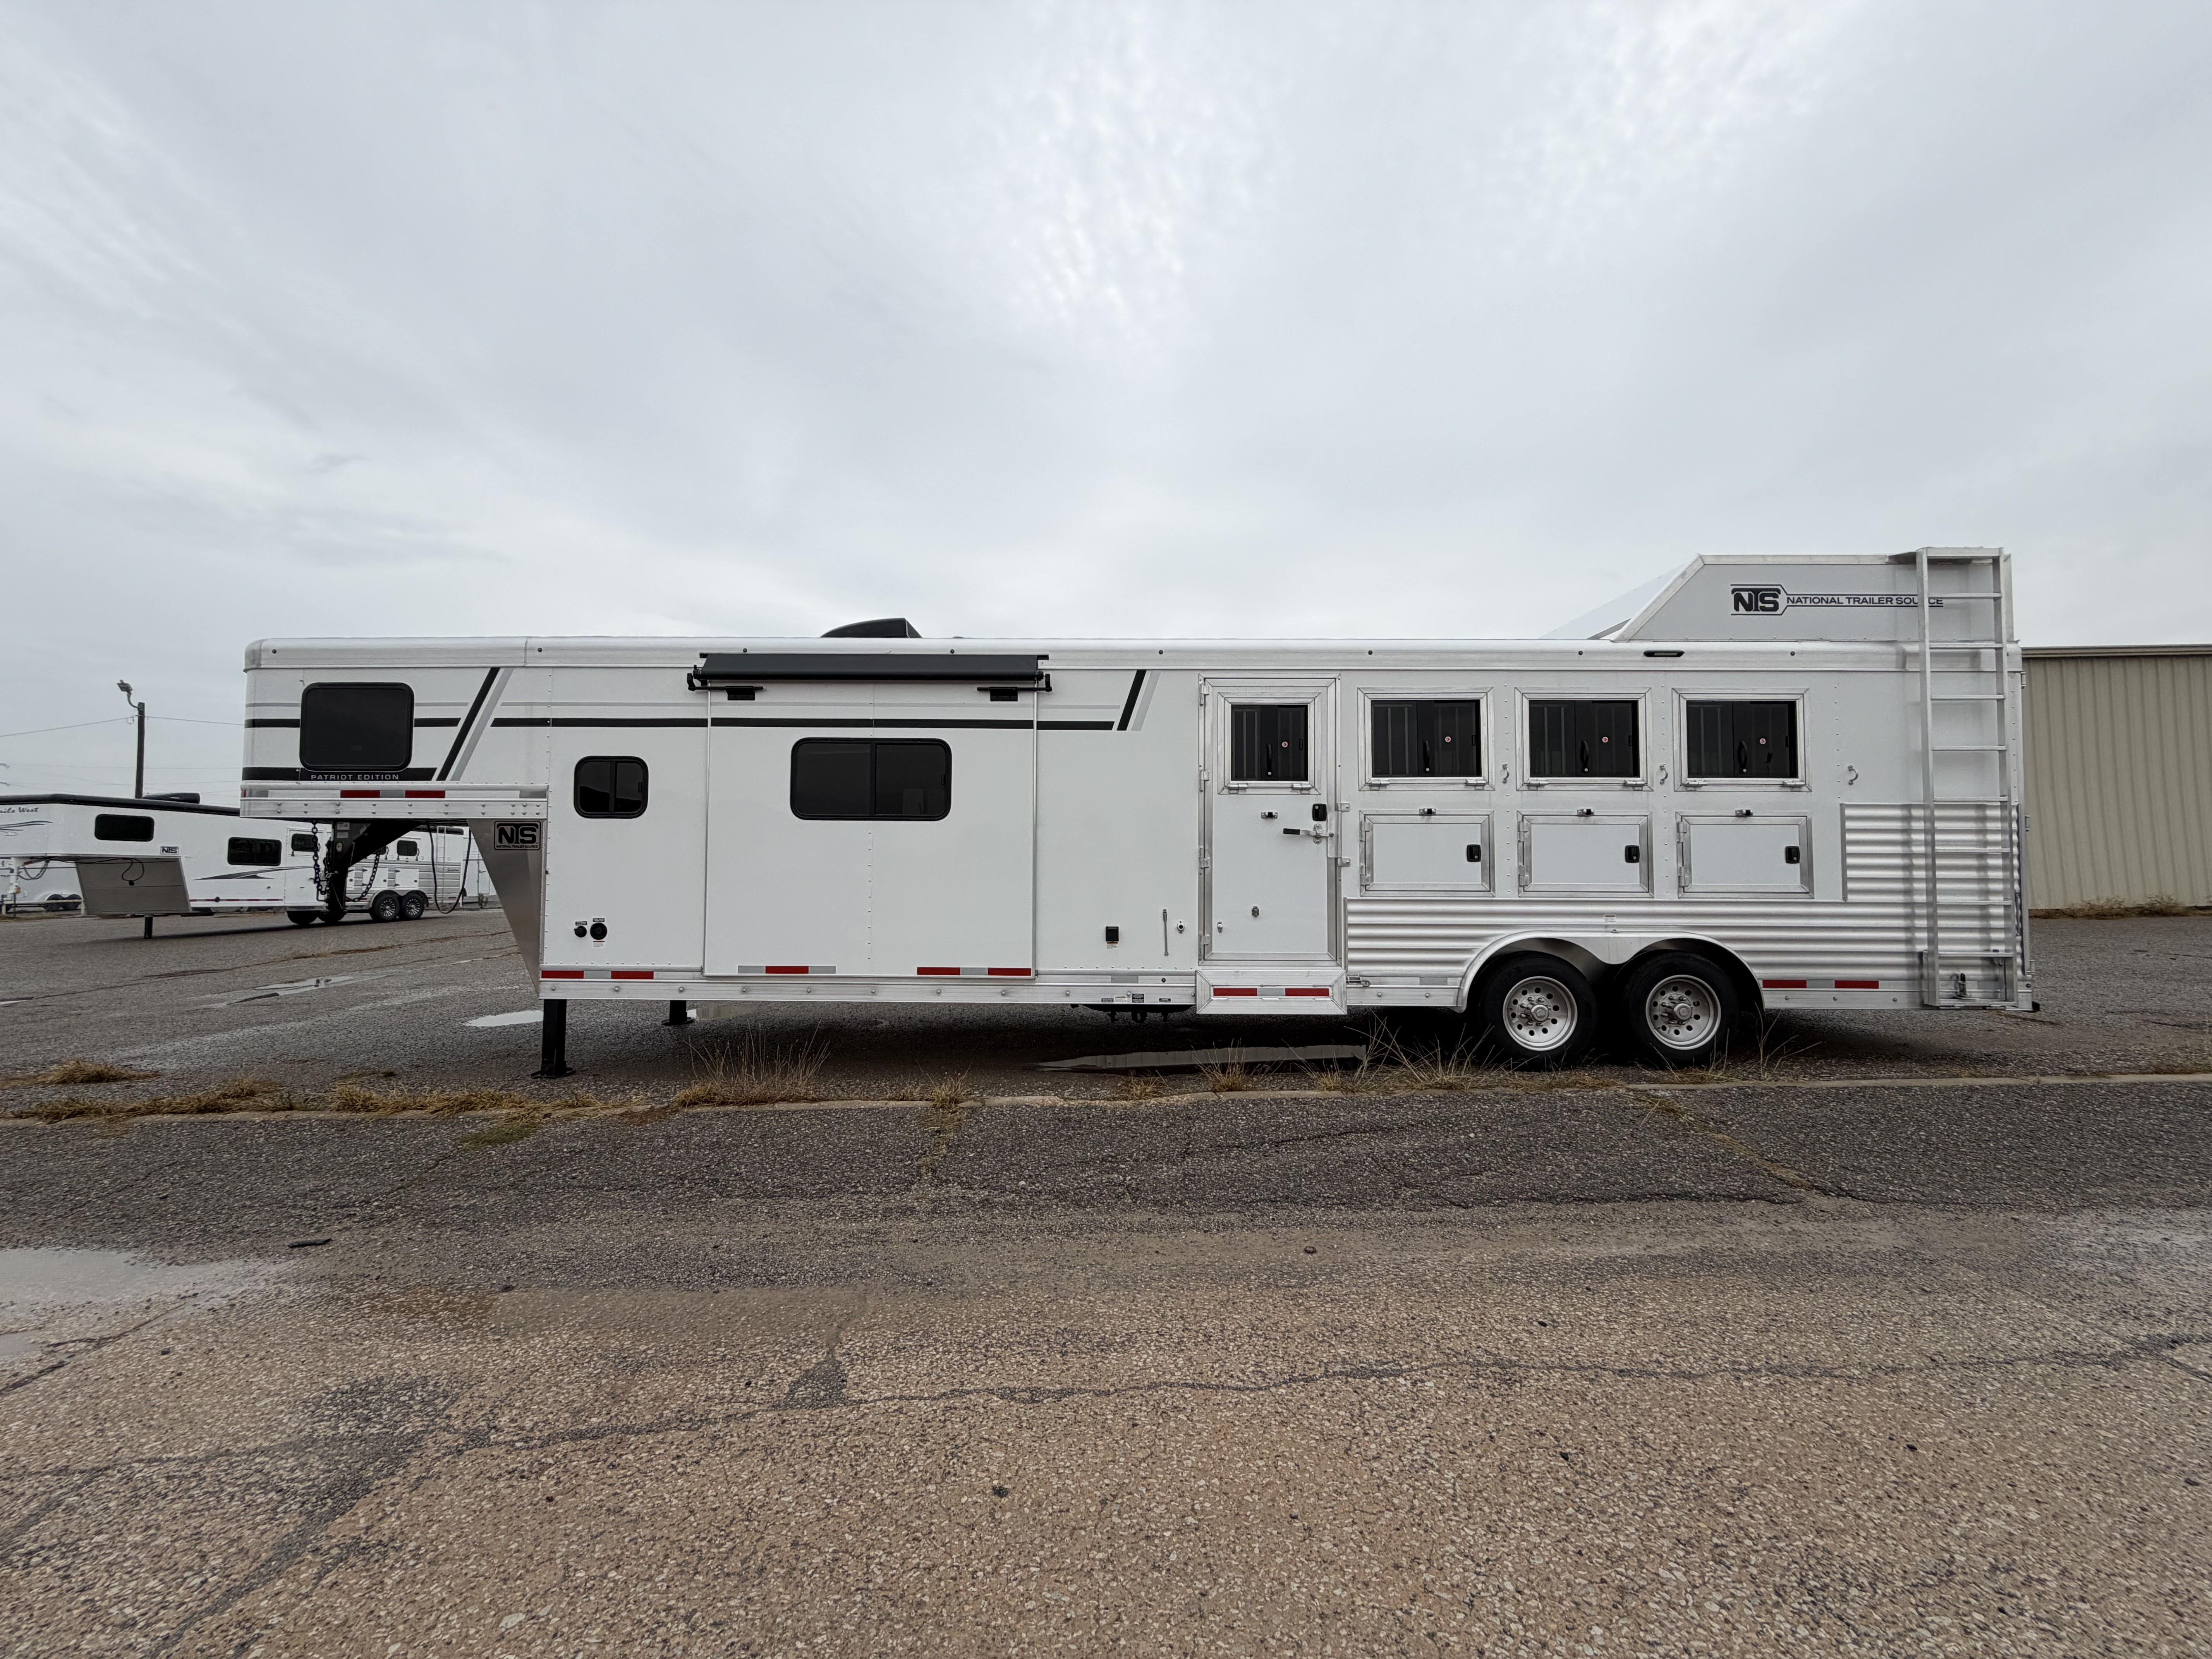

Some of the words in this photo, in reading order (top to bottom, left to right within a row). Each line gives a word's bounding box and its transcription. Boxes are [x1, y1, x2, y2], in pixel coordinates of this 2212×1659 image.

[1731, 588, 1781, 612] NTS
[1896, 597, 1944, 605] SOUCE
[496, 823, 539, 844] NTS
